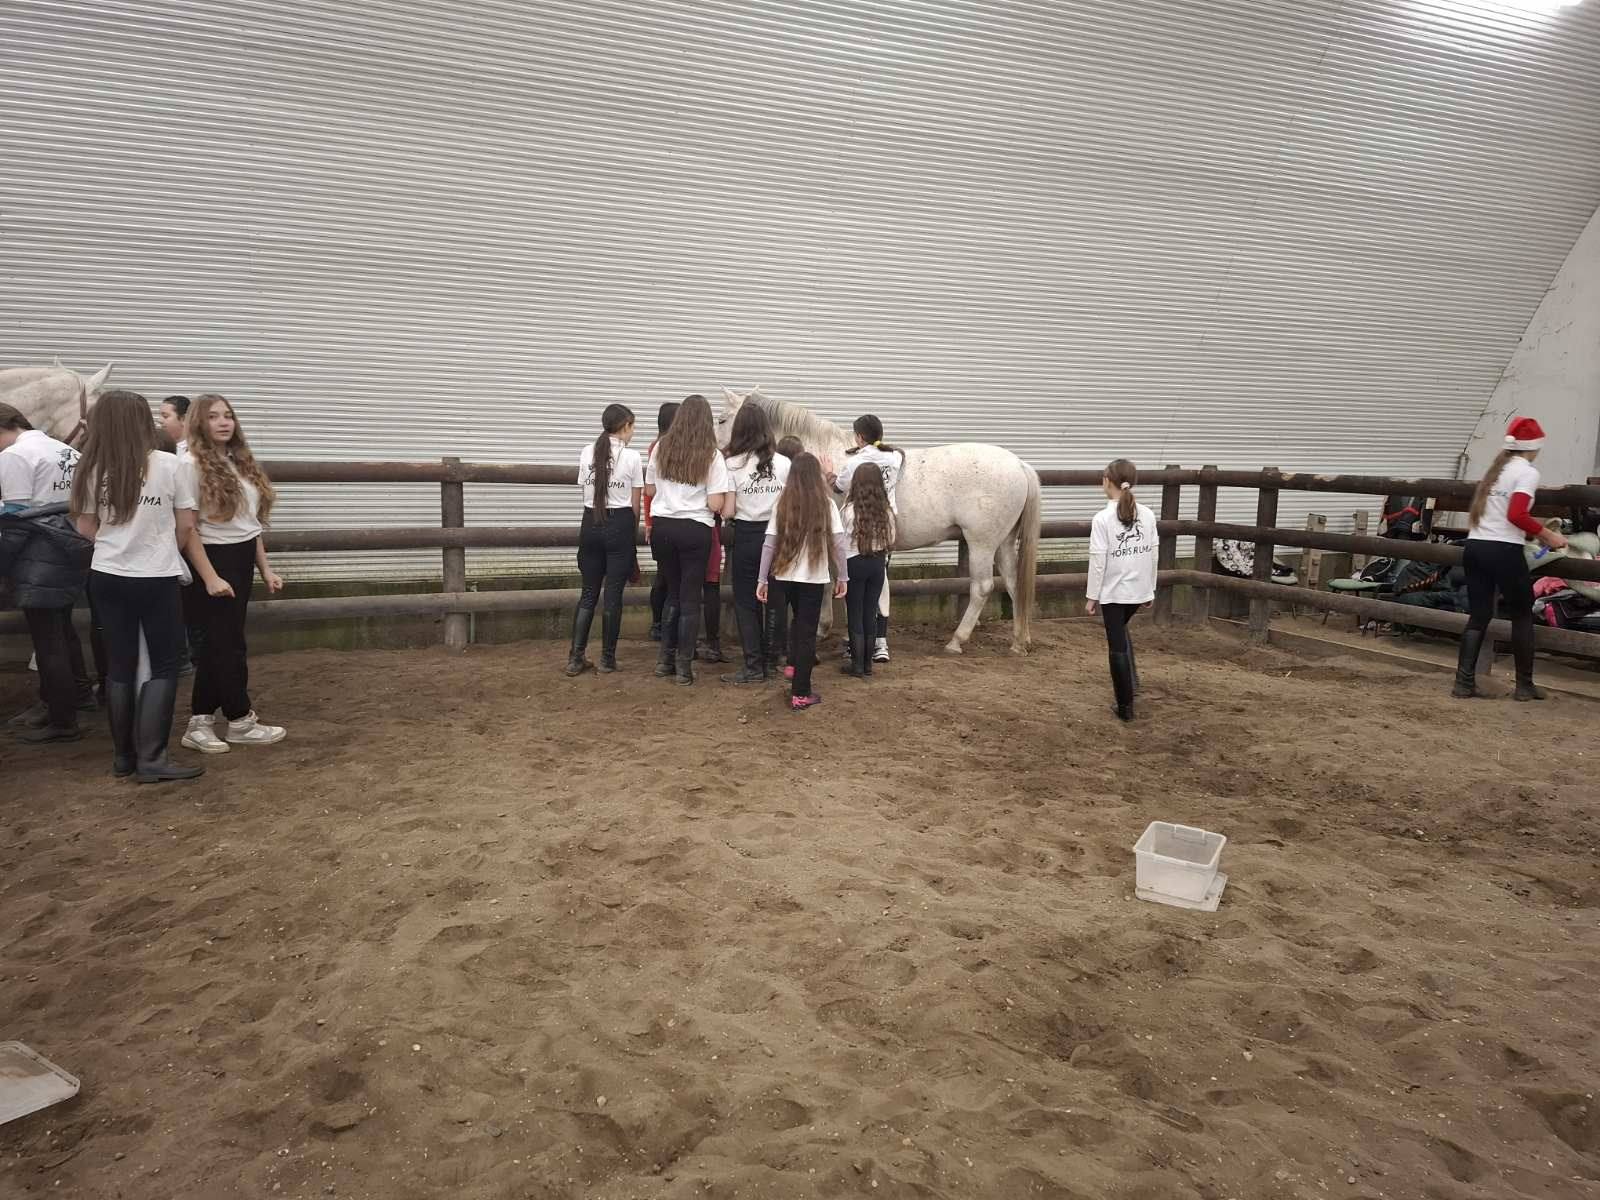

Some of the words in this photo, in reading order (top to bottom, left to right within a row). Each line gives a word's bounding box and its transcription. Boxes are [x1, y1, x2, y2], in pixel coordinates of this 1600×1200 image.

[53, 480, 71, 491] HOR
[608, 481, 625, 489] UMA
[765, 485, 783, 493] RUM
[137, 496, 162, 506] UMA
